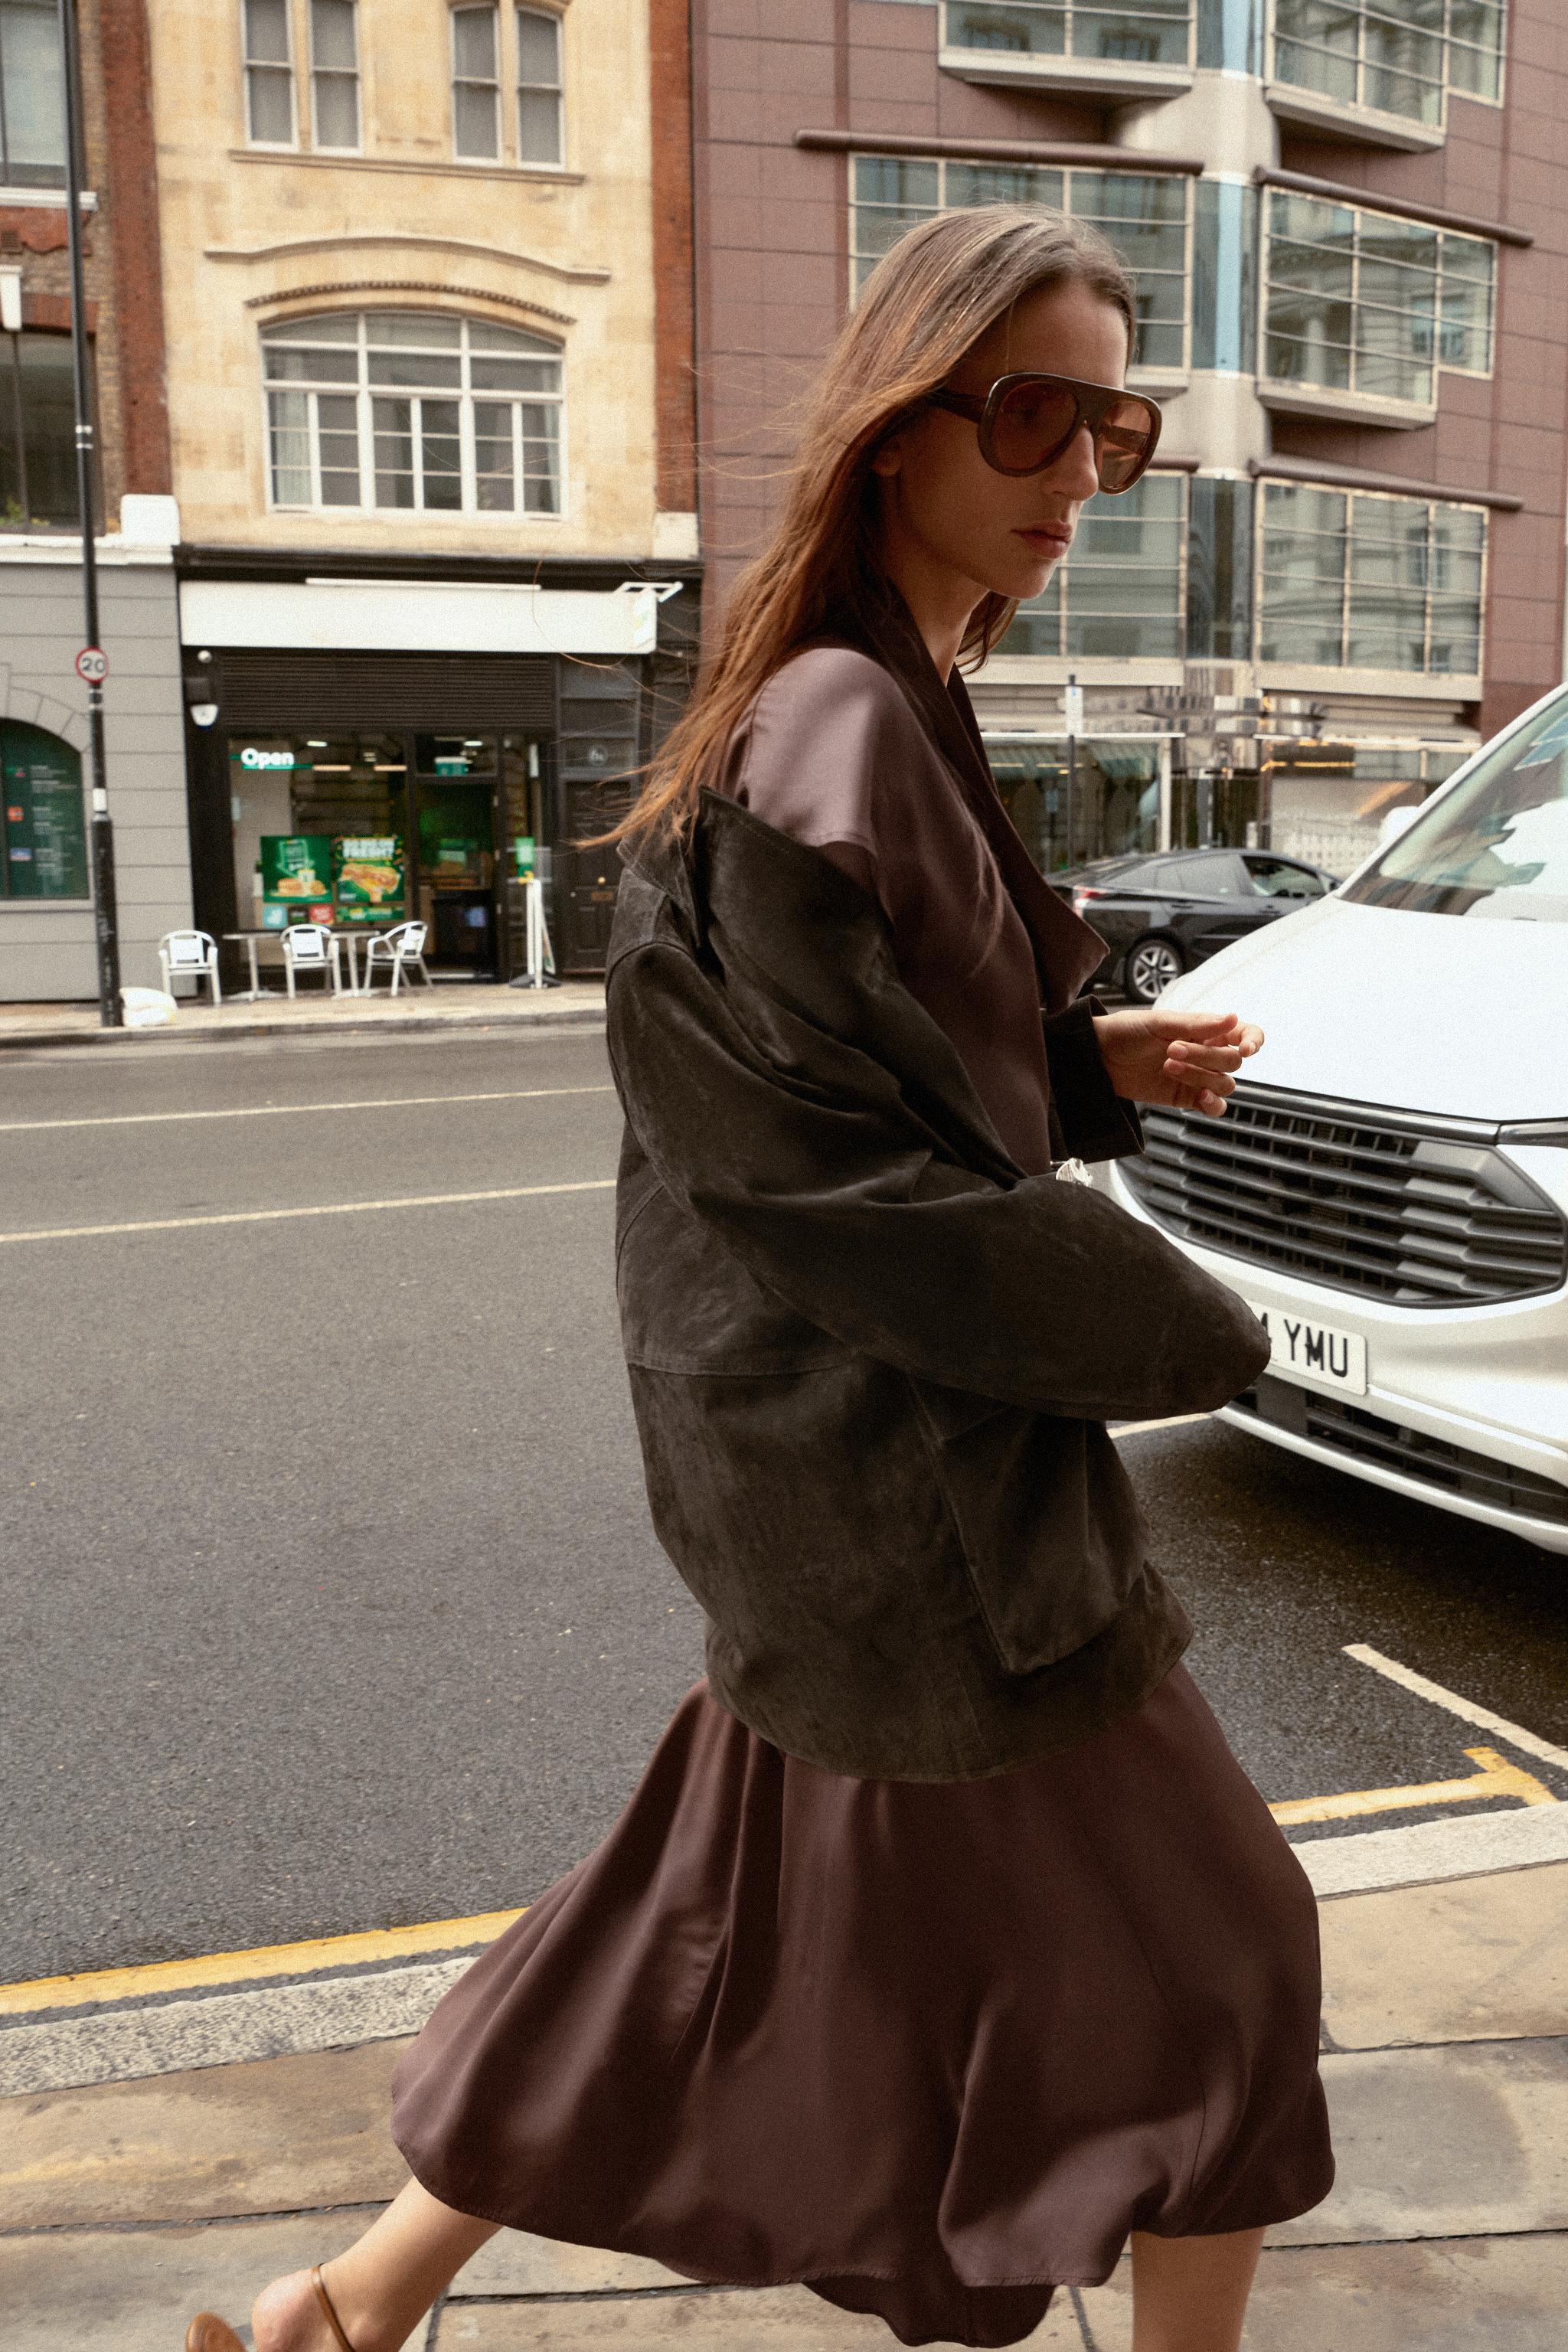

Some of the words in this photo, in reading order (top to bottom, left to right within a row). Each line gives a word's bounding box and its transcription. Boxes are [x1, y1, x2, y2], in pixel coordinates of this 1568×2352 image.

[82, 657, 105, 674] 20
[240, 747, 295, 770] Open
[1284, 1318, 1348, 1378] YMU
